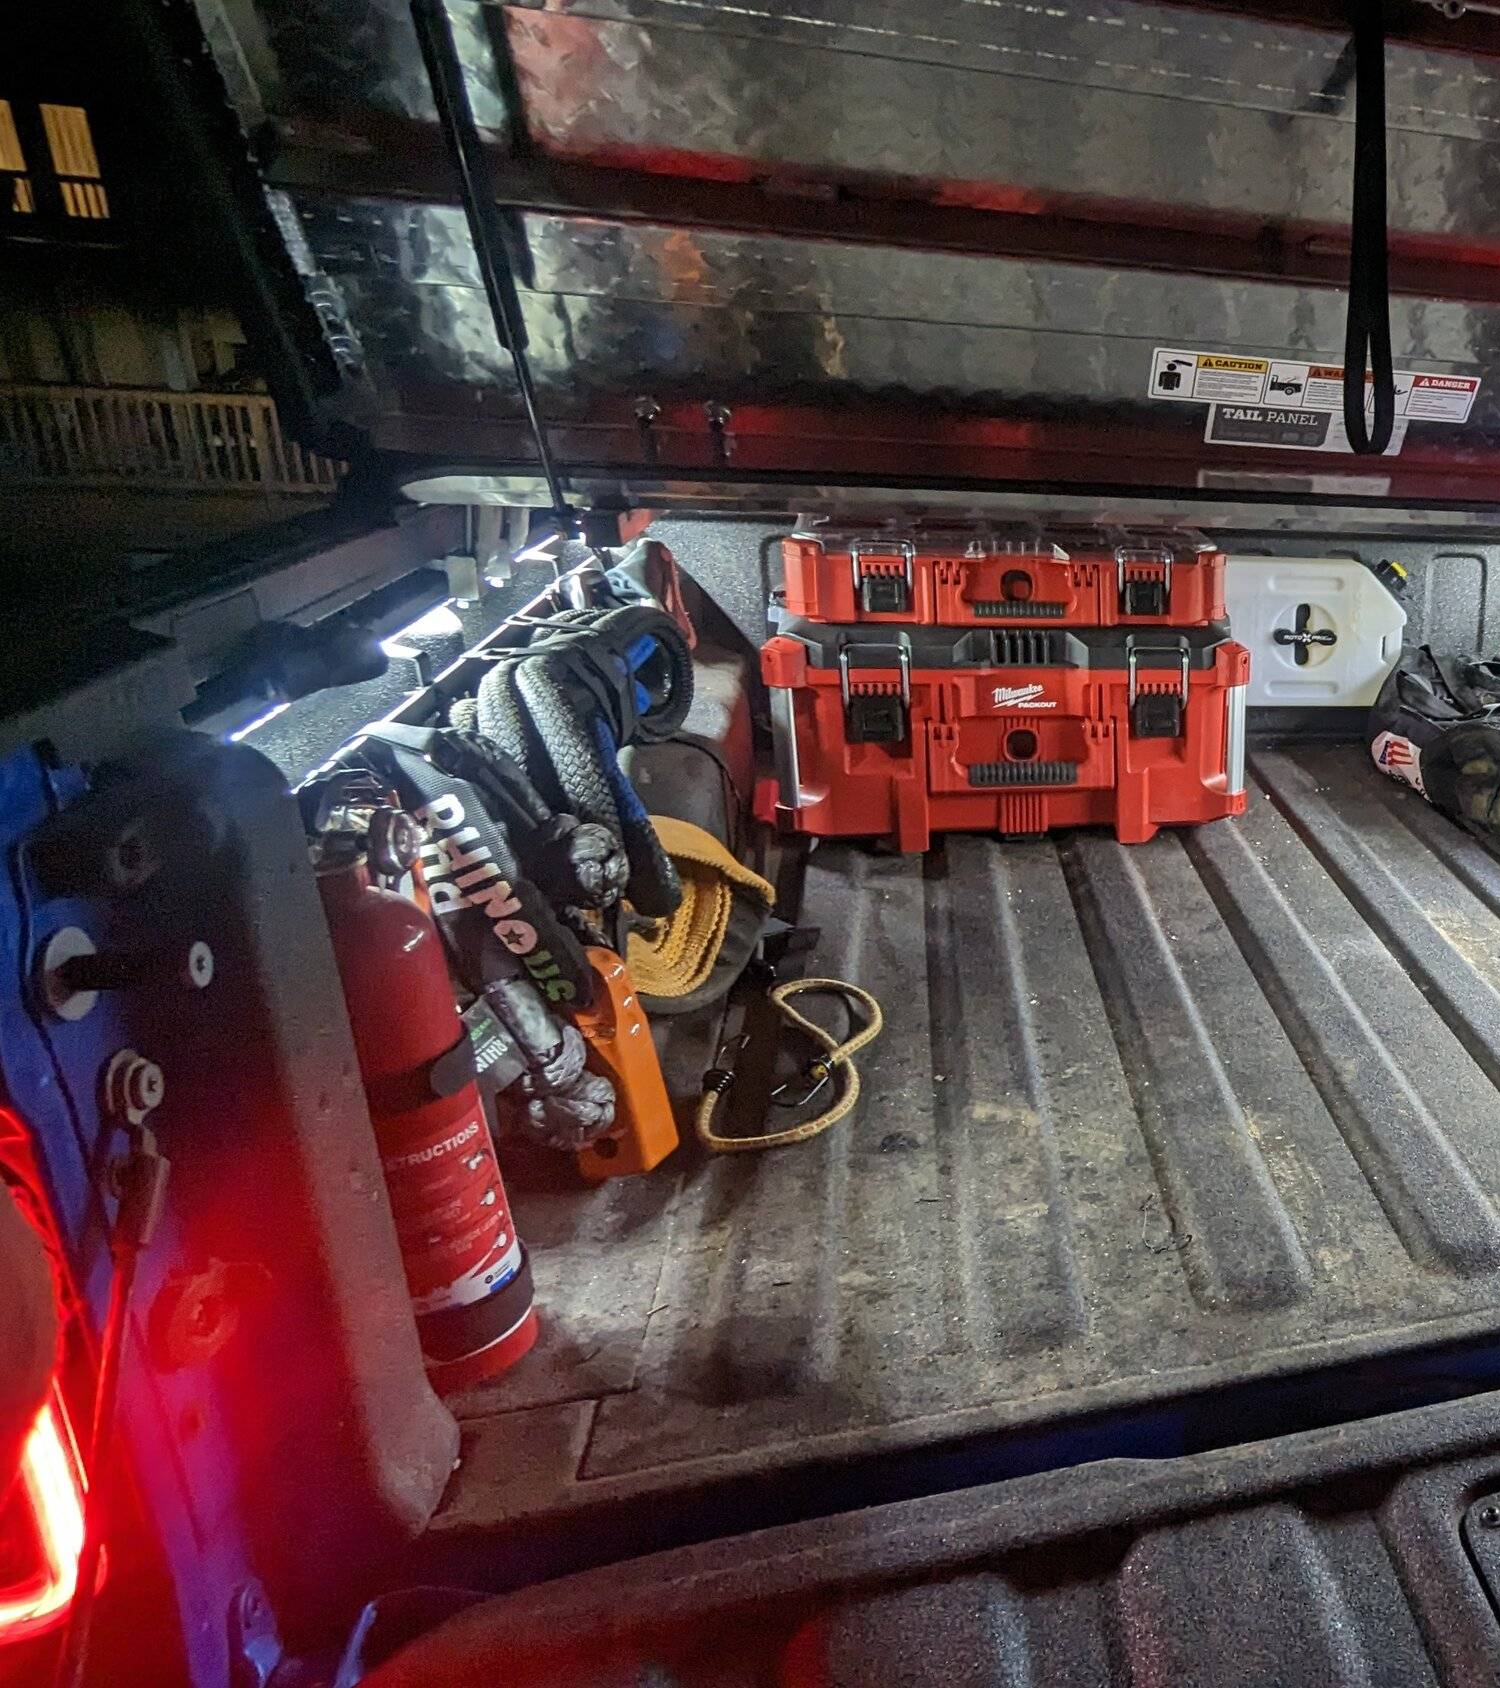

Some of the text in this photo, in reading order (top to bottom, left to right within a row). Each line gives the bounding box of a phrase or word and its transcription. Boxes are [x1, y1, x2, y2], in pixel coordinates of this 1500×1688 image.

[1215, 359, 1263, 370] CAUTION
[1431, 379, 1471, 390] DANGER
[1222, 407, 1318, 426] TAIL PANEL
[992, 684, 1044, 704] Milwaukee
[1018, 701, 1057, 709] PACKOUT
